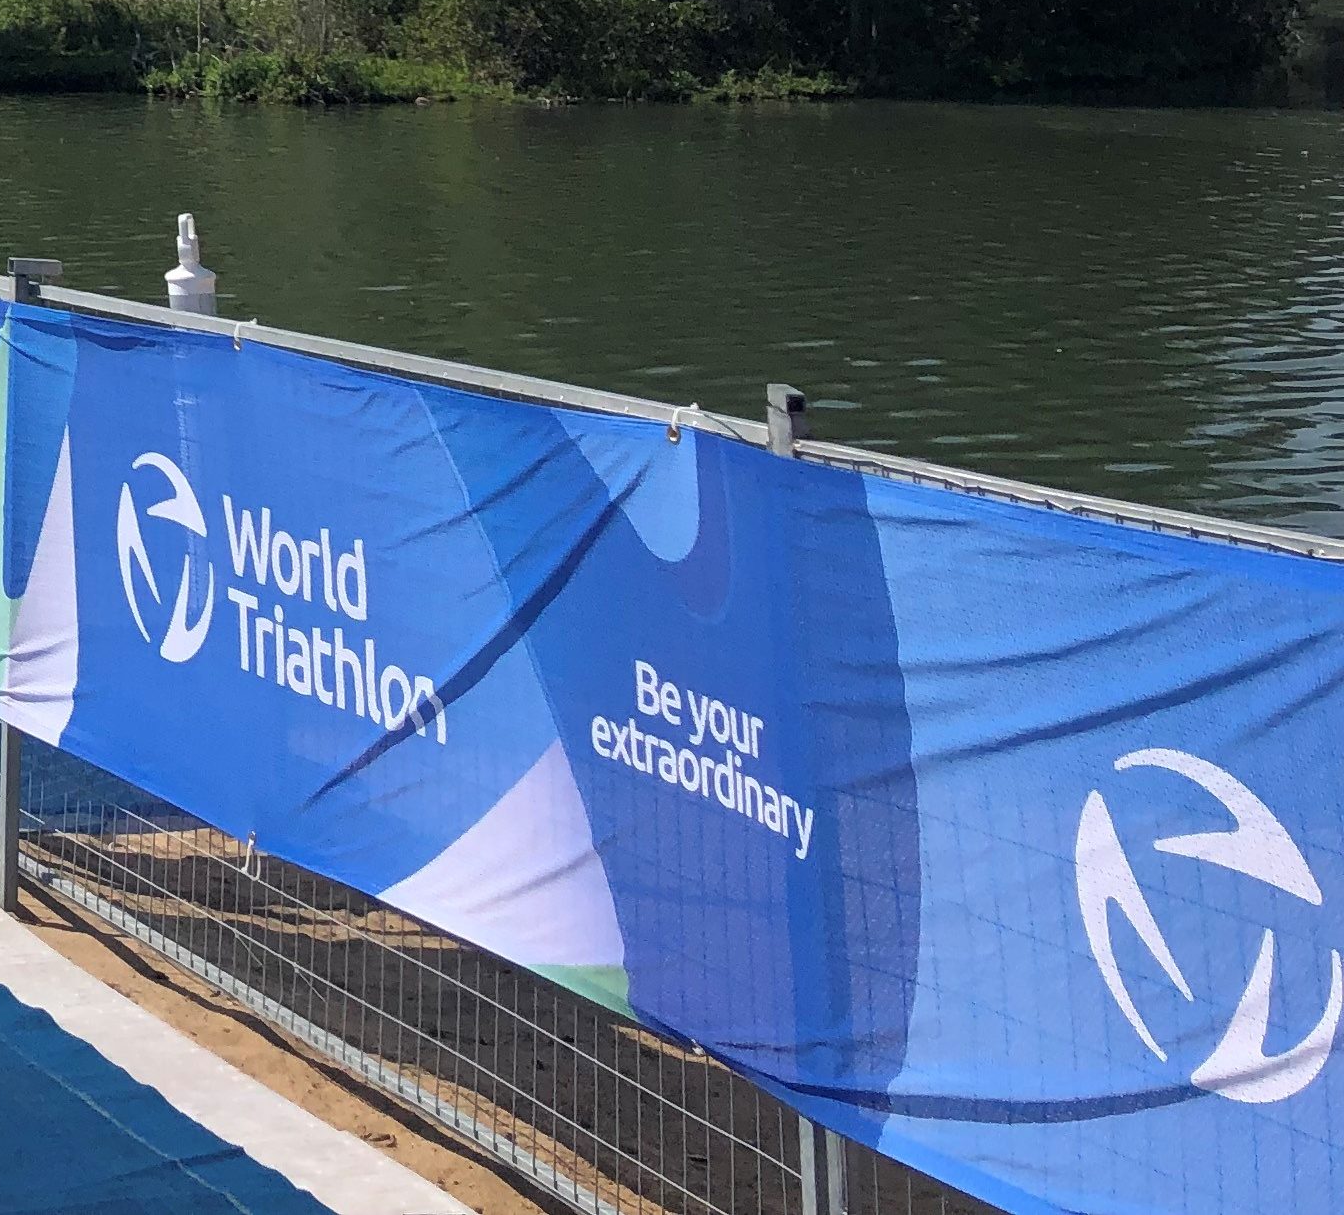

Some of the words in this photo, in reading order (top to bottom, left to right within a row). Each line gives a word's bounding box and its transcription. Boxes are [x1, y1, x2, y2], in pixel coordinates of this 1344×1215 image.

[223, 494, 367, 621] World
[227, 586, 446, 745] Triathlon
[636, 660, 682, 725] Be
[686, 689, 764, 760] your
[591, 715, 814, 861] extraordinary
